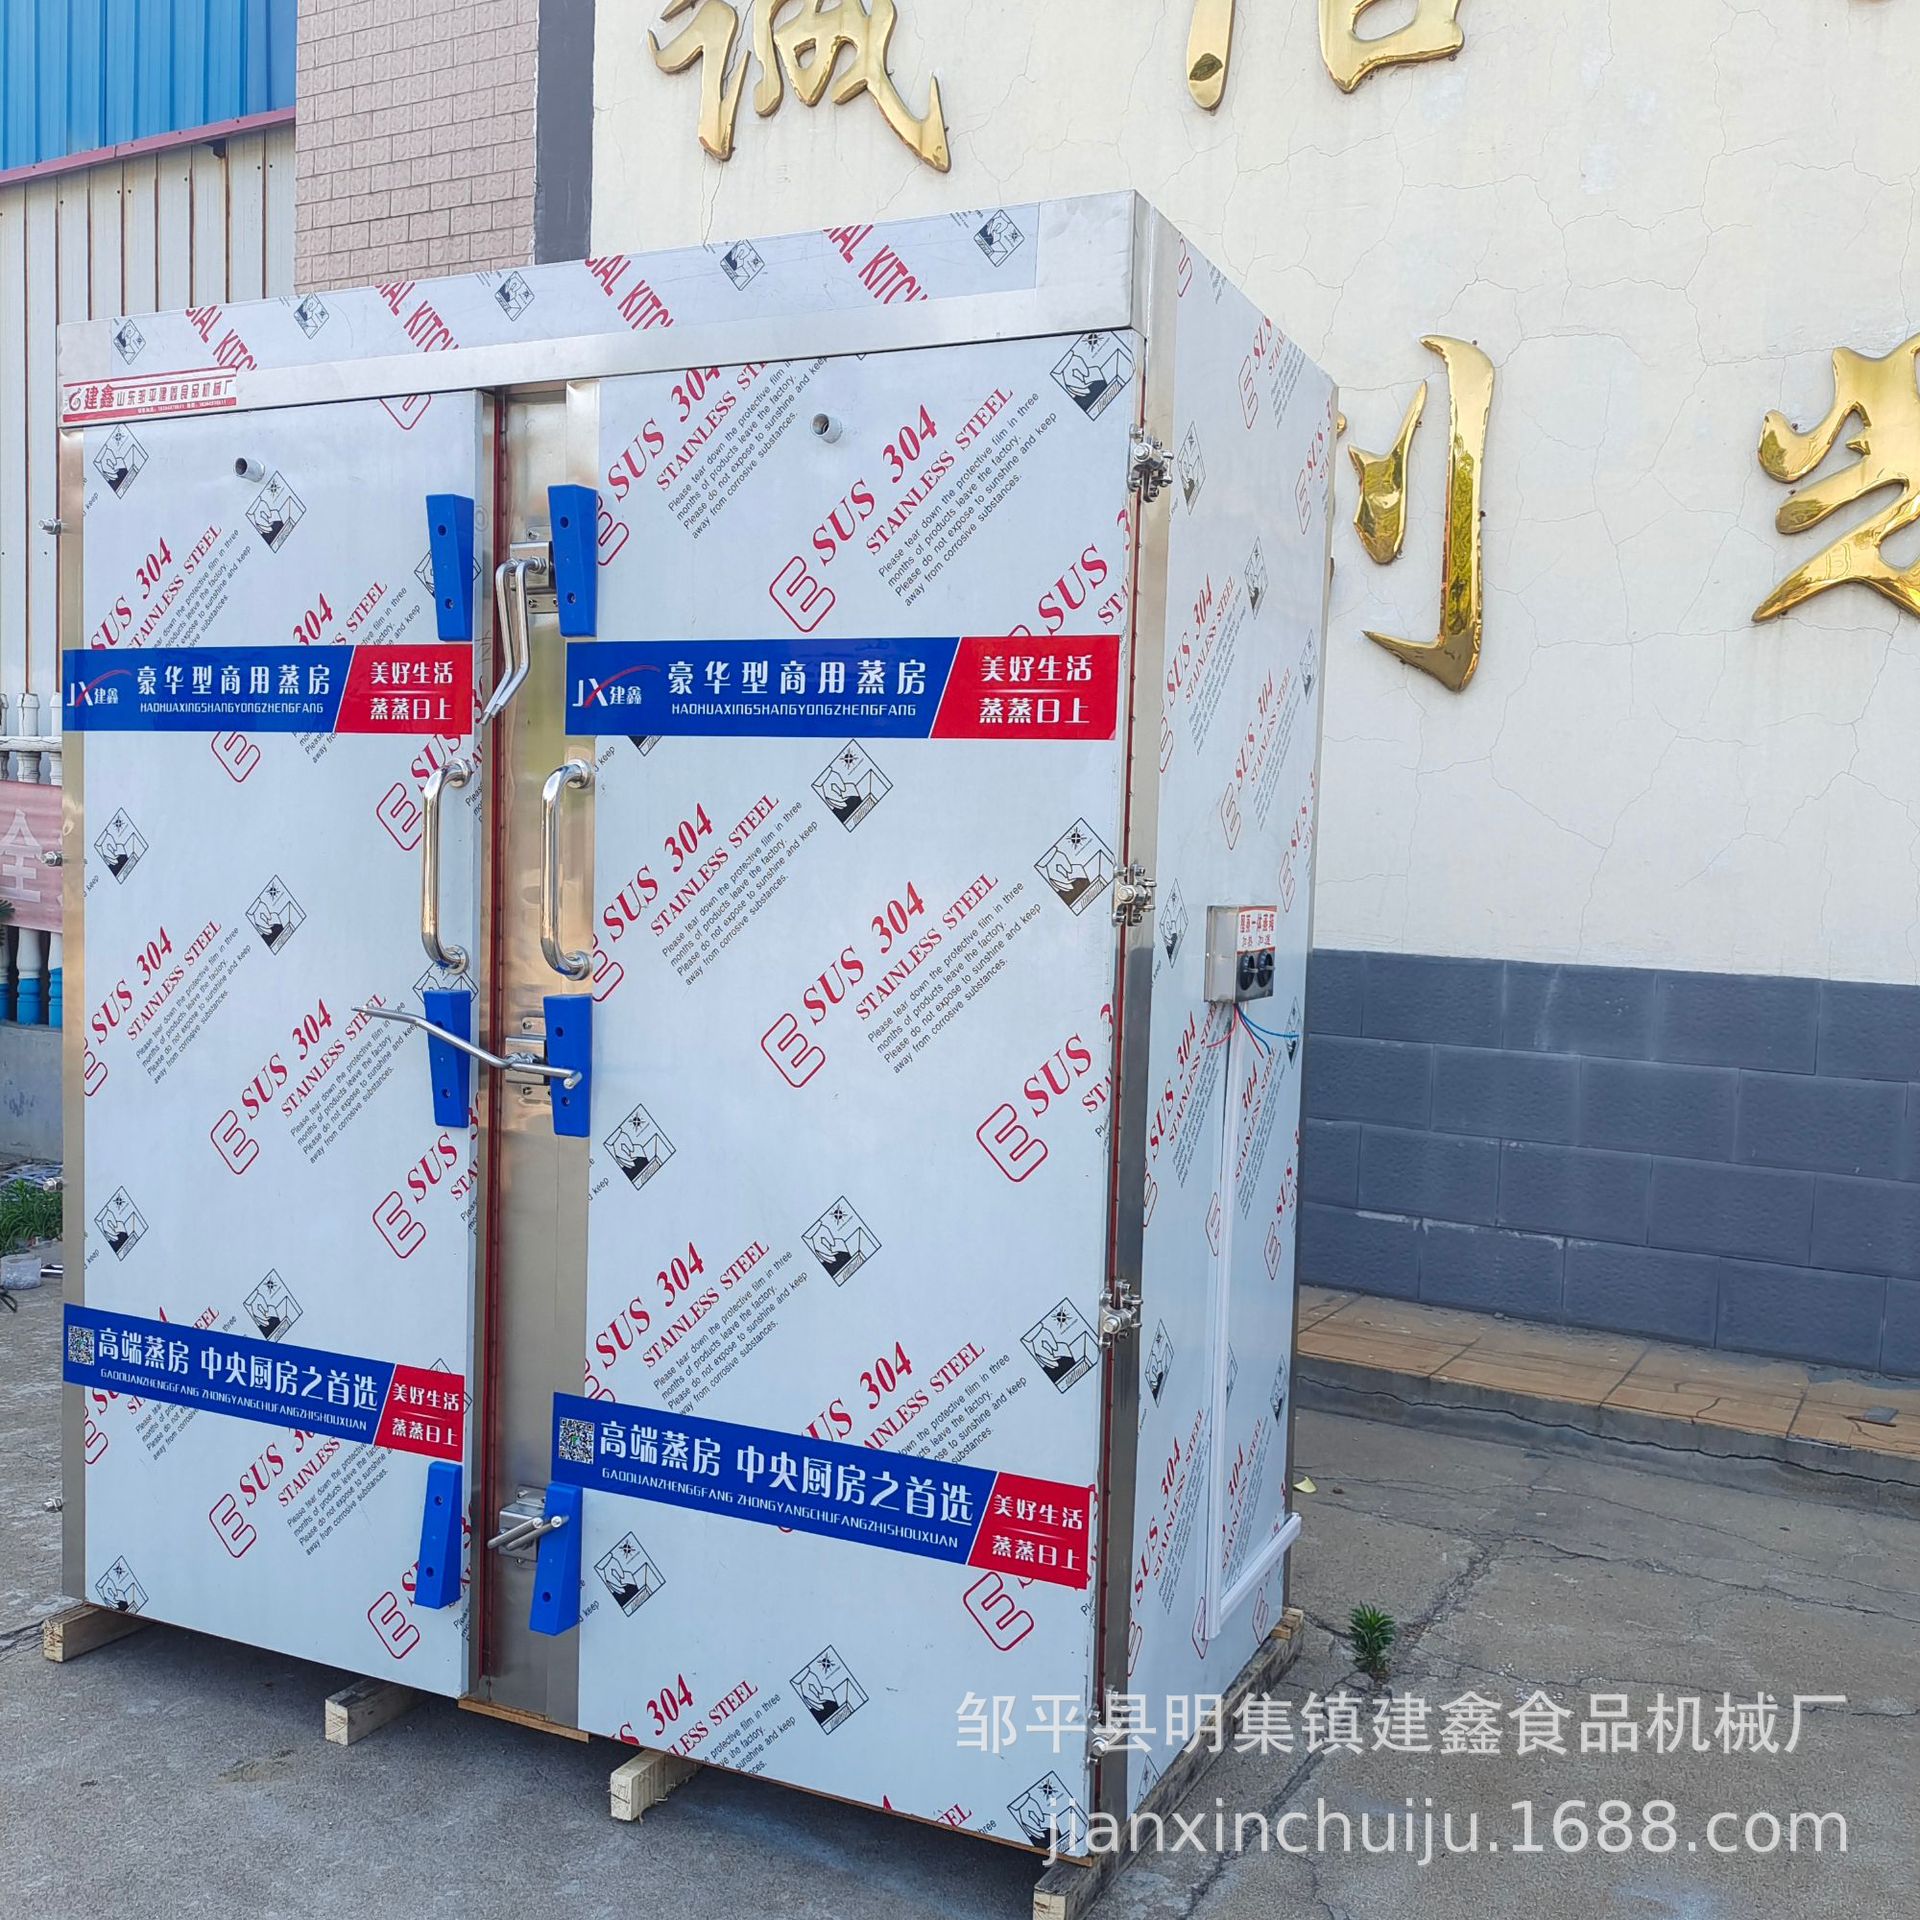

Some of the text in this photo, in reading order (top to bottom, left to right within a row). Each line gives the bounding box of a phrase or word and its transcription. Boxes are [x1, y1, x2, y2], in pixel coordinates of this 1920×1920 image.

[83, 384, 114, 409] 建鑫
[608, 417, 664, 502] SUS
[656, 390, 736, 490] STAINLESS
[866, 388, 1012, 555] STAINLESS STEEL
[812, 478, 875, 566] SUS
[882, 404, 936, 483] 304
[878, 393, 1038, 577] Please tear down the protective film in three
[888, 435, 1020, 586] months of products leave the factory.
[895, 412, 1056, 596] Please do not expose to sunshine and keep
[184, 525, 221, 575] STEEL
[905, 474, 1021, 606] away from corrosive substances.
[91, 536, 171, 649] SUS 304
[346, 581, 387, 633] STEEL
[1038, 543, 1108, 636] SUS
[94, 688, 119, 705] 建鑫
[137, 664, 330, 695] 豪华型商用蒸房
[370, 661, 453, 684] 美好生活
[370, 698, 453, 720] 蒸蒸日上
[609, 685, 642, 705] 建鑫
[668, 660, 926, 695] 豪华型商用蒸房
[980, 655, 1093, 682] 美好生活
[1167, 632, 1190, 707] SUS
[979, 697, 1091, 724] 蒸蒸日上
[1235, 722, 1255, 791] SUS
[603, 802, 712, 942] SUS 304
[651, 794, 779, 936] STAINLESS STEEL
[92, 926, 172, 1045] SUS 304
[127, 920, 221, 1040] STAINLESS STEEL
[803, 944, 864, 1026] SUS
[871, 881, 924, 953] 304
[855, 874, 998, 1020] STAINLESS STEEL
[867, 883, 1023, 1042] Please tear down the protective film in three
[242, 1052, 287, 1121] SUS
[292, 998, 331, 1060] 304
[281, 1038, 344, 1117] STAINLESS
[1023, 1033, 1092, 1118] SUS
[1150, 1080, 1174, 1162] SUS
[407, 1132, 458, 1205] SUS
[596, 1241, 703, 1369] SUS 304
[642, 1240, 769, 1368] STAINLESS STEEL
[662, 1285, 776, 1399] months of products leave the factory.
[98, 1327, 378, 1412] 高端蒸房 中央厨房之首选
[392, 1382, 460, 1413] 美好生活
[860, 1340, 911, 1409] 304
[929, 1342, 984, 1394] STEEL
[278, 1435, 339, 1507] STAINLESS
[391, 1417, 459, 1447] 蒸蒸日上
[239, 1442, 283, 1507] SUS
[600, 1421, 974, 1527] 高端蒸房 中央厨房之首选
[993, 1494, 1083, 1530] 美好生活
[991, 1535, 1081, 1571] 蒸蒸日上
[1133, 1514, 1159, 1605] SUS
[646, 1673, 692, 1736] 304
[709, 1680, 757, 1726] STEEL
